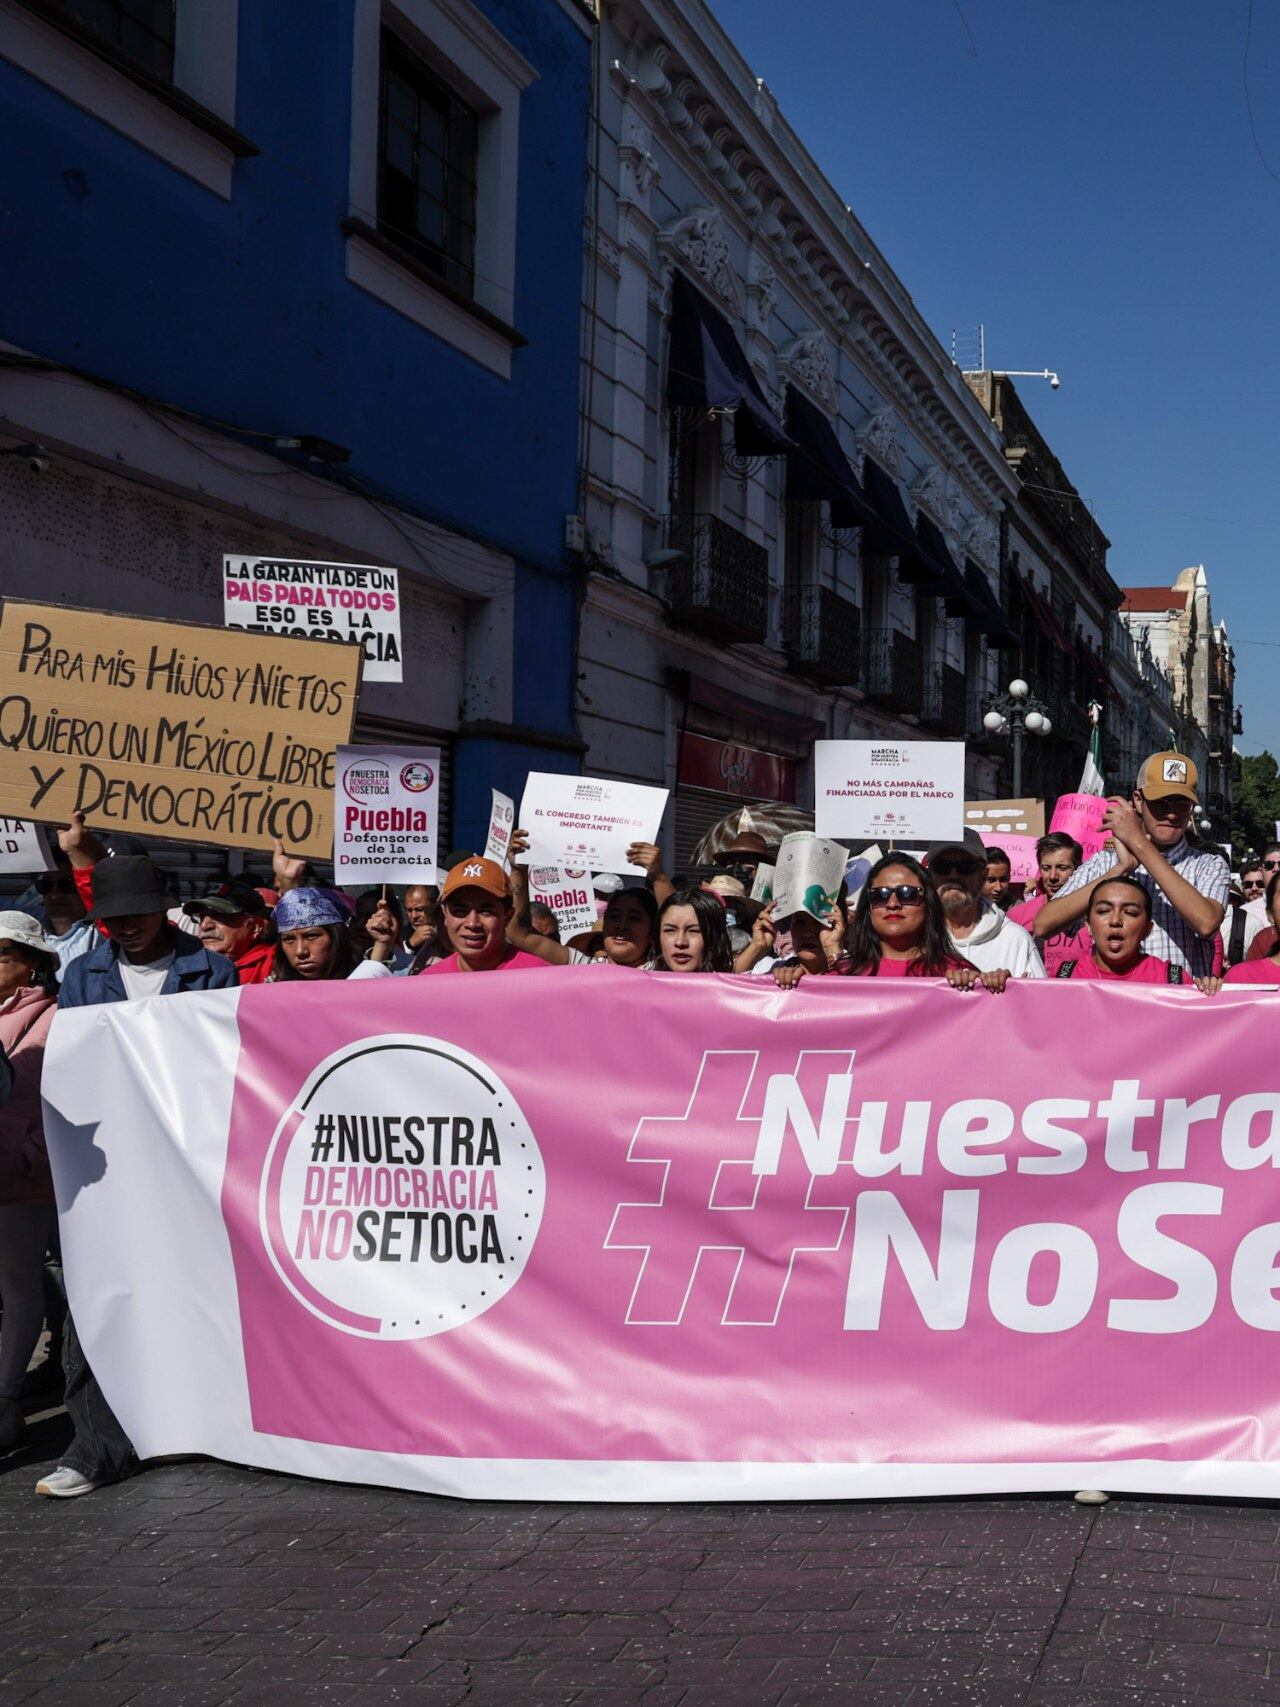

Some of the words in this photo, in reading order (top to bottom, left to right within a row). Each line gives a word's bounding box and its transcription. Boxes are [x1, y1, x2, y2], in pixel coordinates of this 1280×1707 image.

[226, 561, 249, 579] LA
[345, 571, 367, 588] DE
[371, 573, 394, 590] UN
[226, 579, 272, 602] PAÍS
[275, 584, 327, 607] PARA
[327, 588, 396, 611] TODOS
[256, 605, 295, 623] ESO
[307, 608, 333, 625] ES
[348, 611, 372, 628] LA
[232, 667, 250, 702] Y
[109, 721, 148, 764] UN
[350, 770, 389, 779] #NUESTRA
[863, 778, 882, 787] MÁS
[884, 779, 935, 788] CAMPAÑAS
[29, 765, 65, 810] Y
[826, 789, 887, 797] FINANCIADAS
[346, 806, 427, 831] Puebla
[546, 810, 591, 821] CONGRESO
[559, 820, 613, 831] IMPORTANTE
[344, 832, 429, 843] Defensores
[367, 844, 385, 853] de
[389, 844, 406, 853] la
[340, 855, 432, 865] Democracia
[310, 1113, 501, 1167] #NUESTRA
[304, 1165, 499, 1211] DEMOCRACIA
[295, 1211, 505, 1265] NOSETOCA
